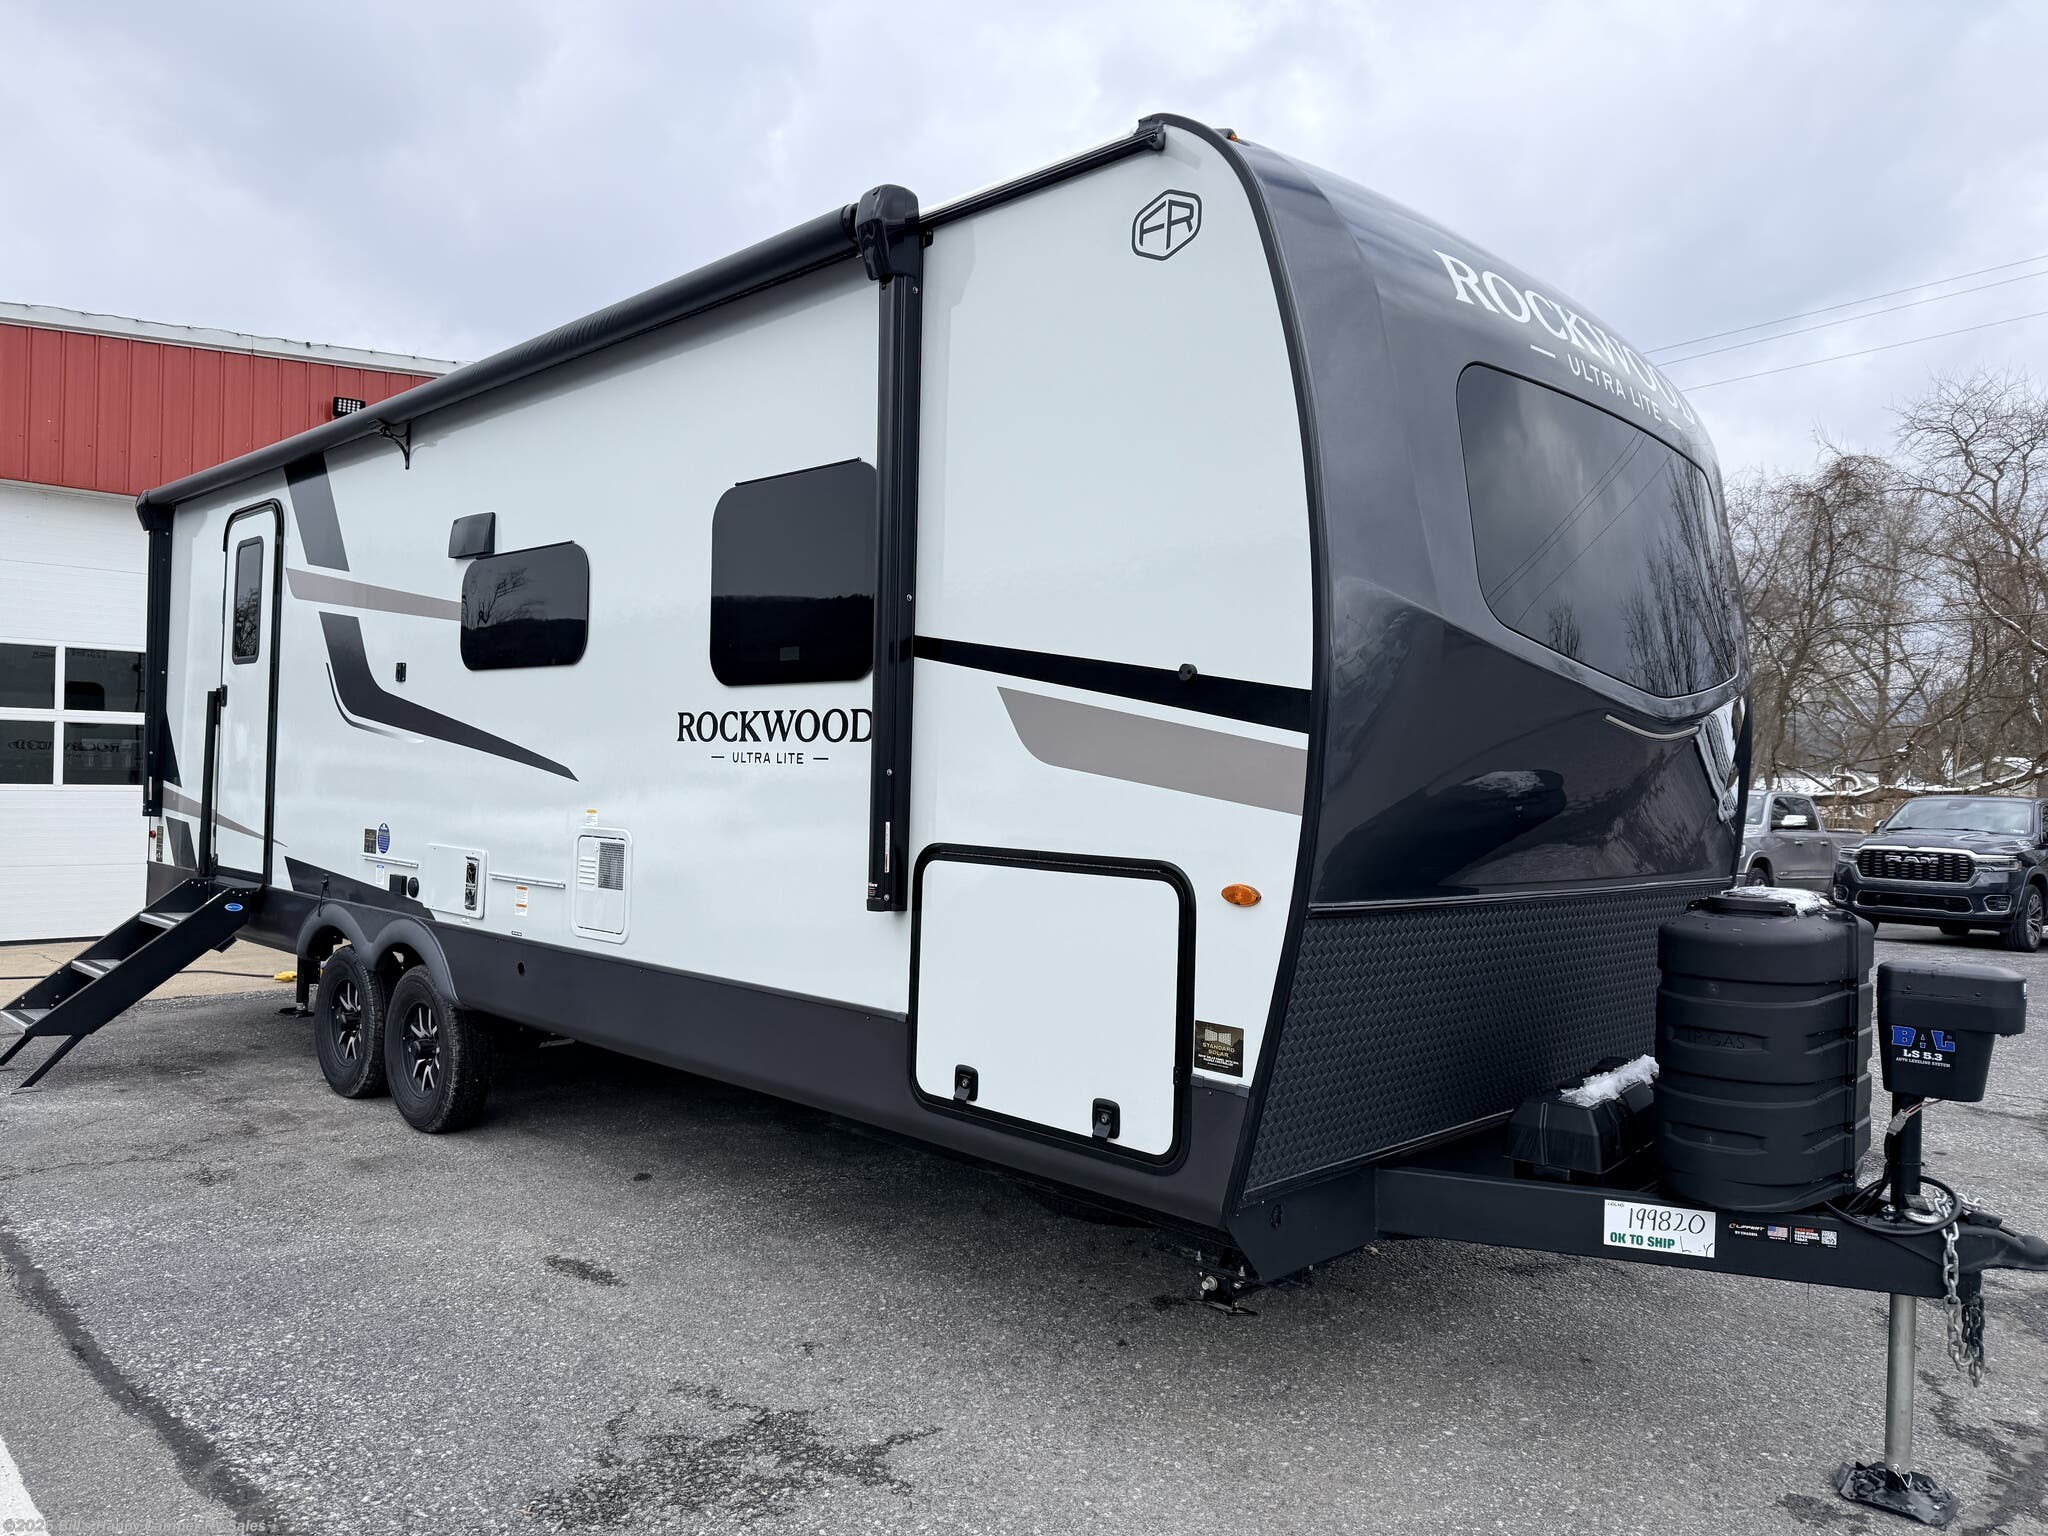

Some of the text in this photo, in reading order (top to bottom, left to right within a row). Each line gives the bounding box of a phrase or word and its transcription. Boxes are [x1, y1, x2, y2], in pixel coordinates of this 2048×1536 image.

[1432, 249, 1696, 425] ROCKWOOD
[1567, 353, 1662, 422] ULTRA LITE
[677, 708, 872, 743] ROCKWOOD
[732, 752, 804, 765] ULTRA LITE
[1885, 854, 1939, 864] RAM
[1903, 1049, 1943, 1062] LS 5.3
[1628, 1207, 1706, 1235] 199820
[1610, 1231, 1675, 1249] OK TO SHIP
